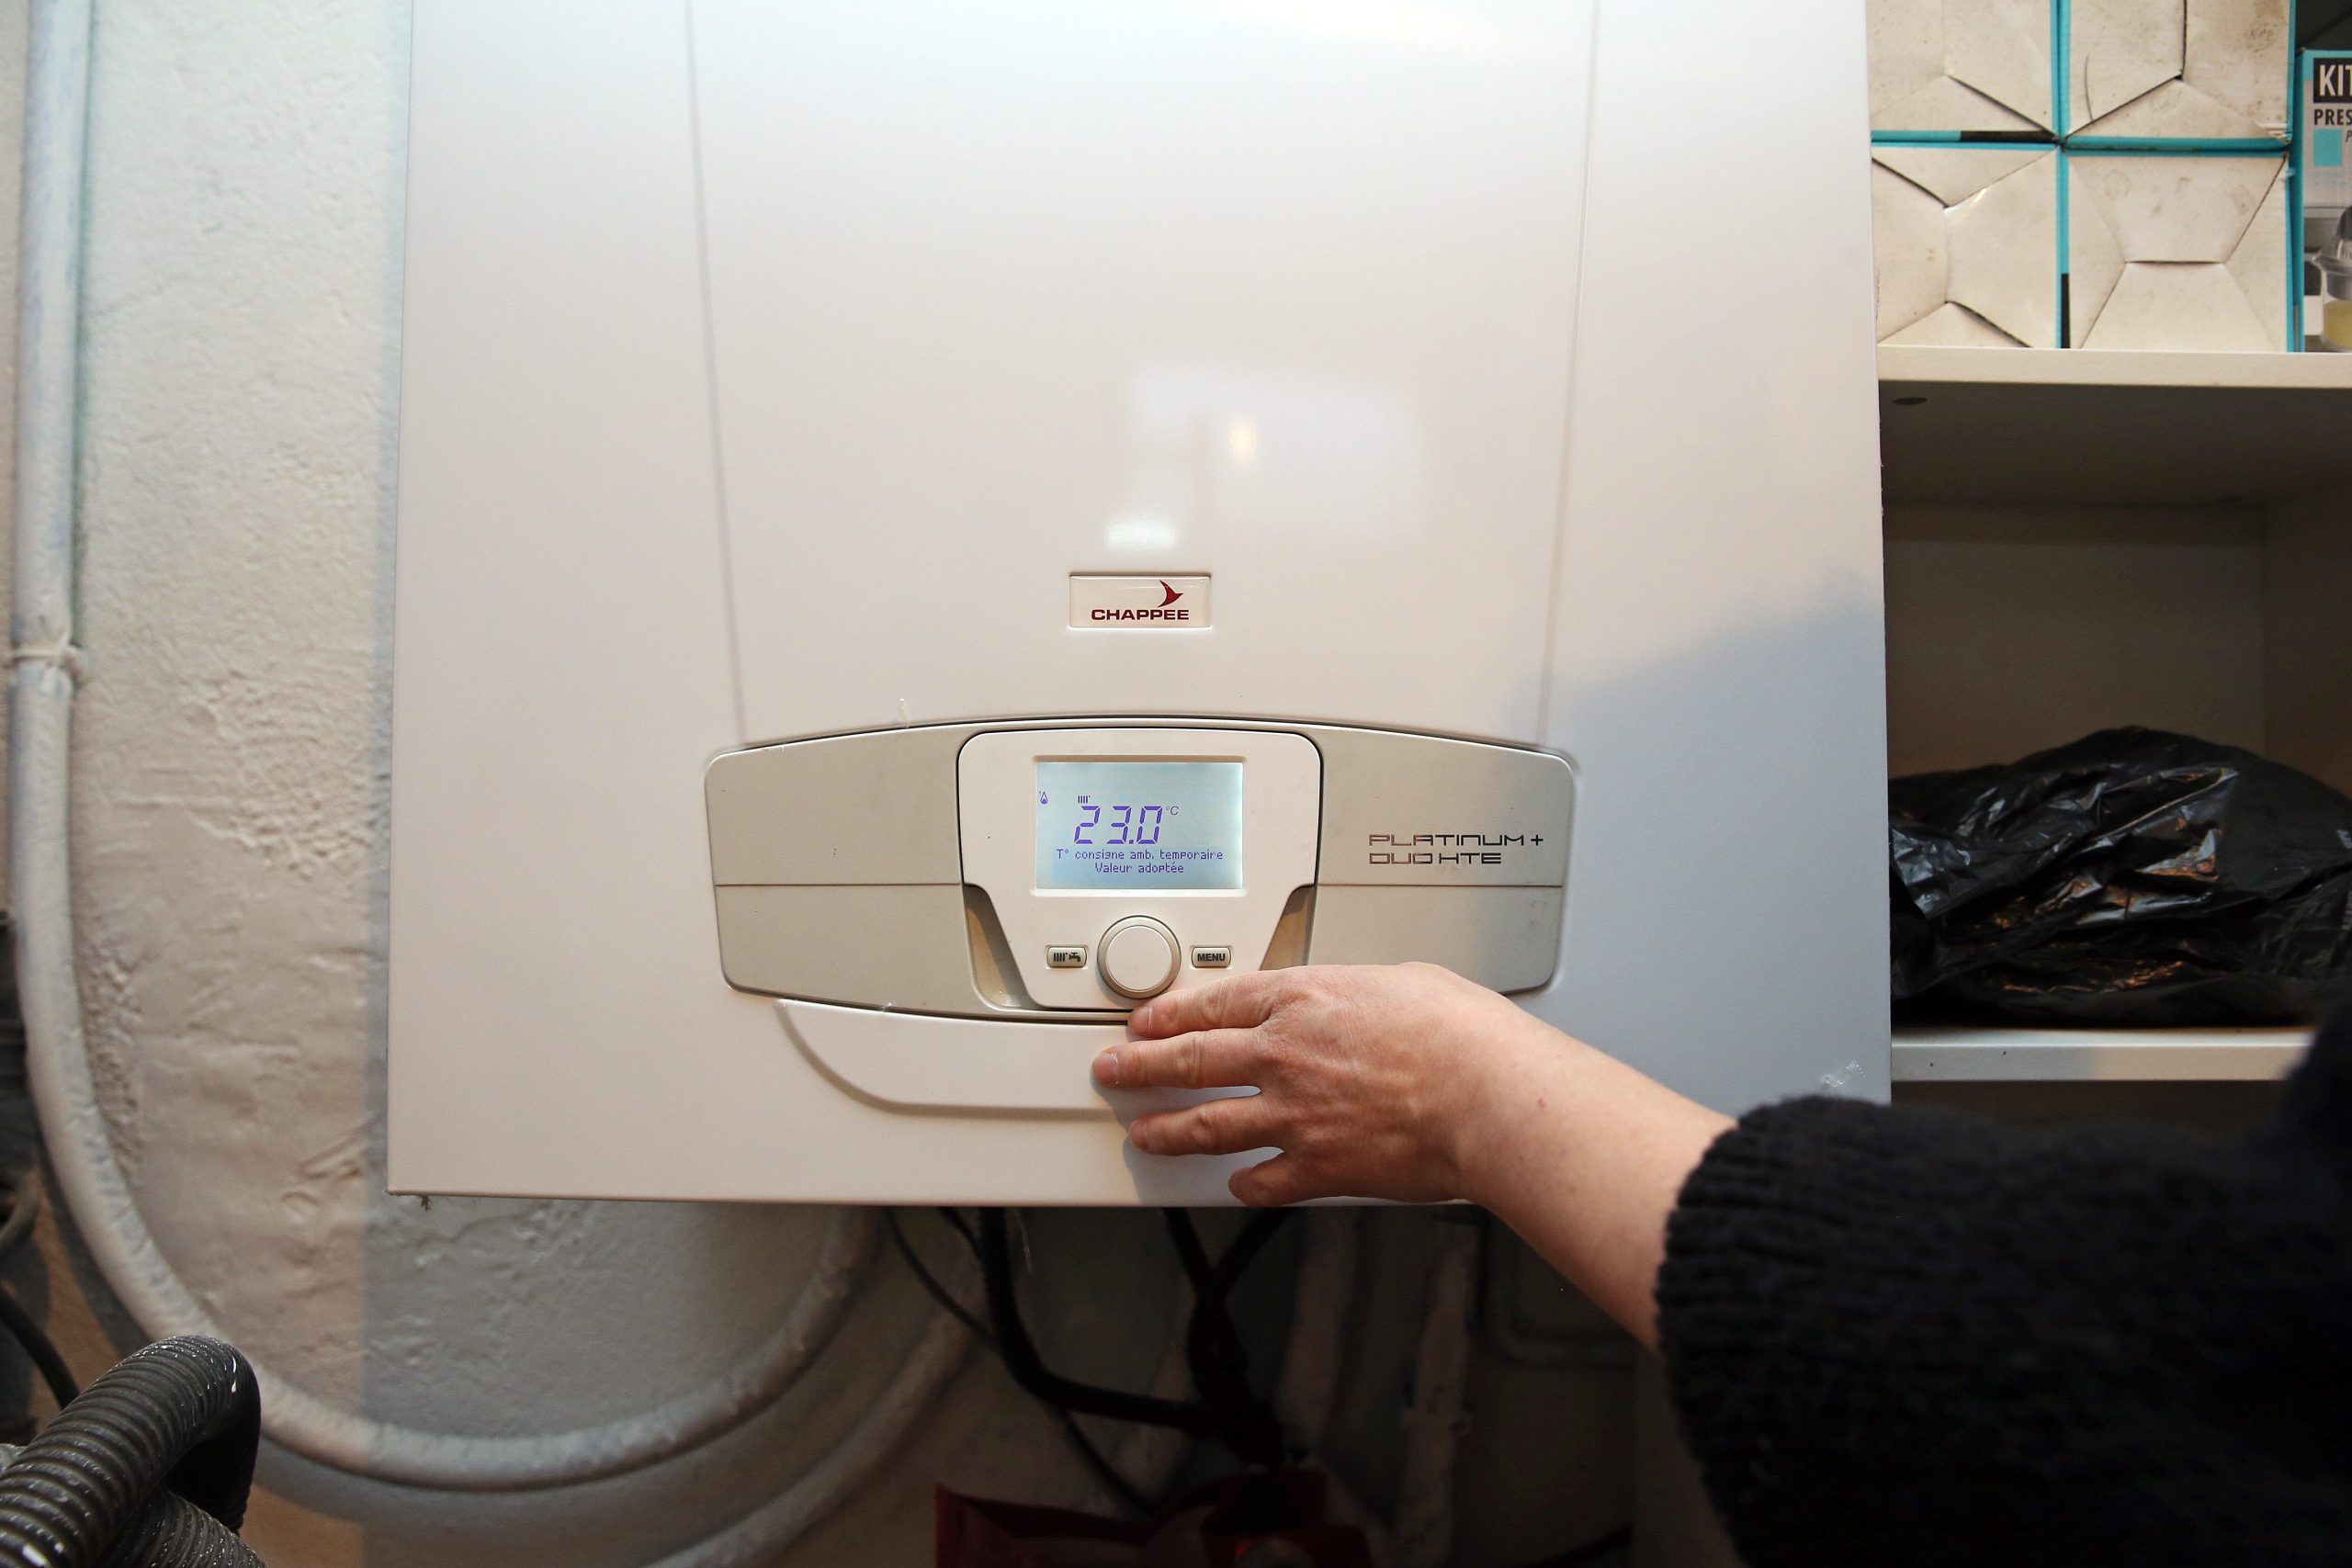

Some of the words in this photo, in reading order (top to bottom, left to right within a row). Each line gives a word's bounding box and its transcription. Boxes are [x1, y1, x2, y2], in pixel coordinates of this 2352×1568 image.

[1091, 609, 1189, 620] CHAPPEE
[1074, 806, 1163, 844] 23.0
[1075, 849, 1125, 860] consigne
[1130, 849, 1155, 859] amb.
[1160, 849, 1223, 860] temporaire
[1369, 852, 1432, 864] DUO
[1439, 852, 1501, 864] HTE
[1095, 863, 1132, 873] Valeur
[1138, 862, 1184, 873] adoptée
